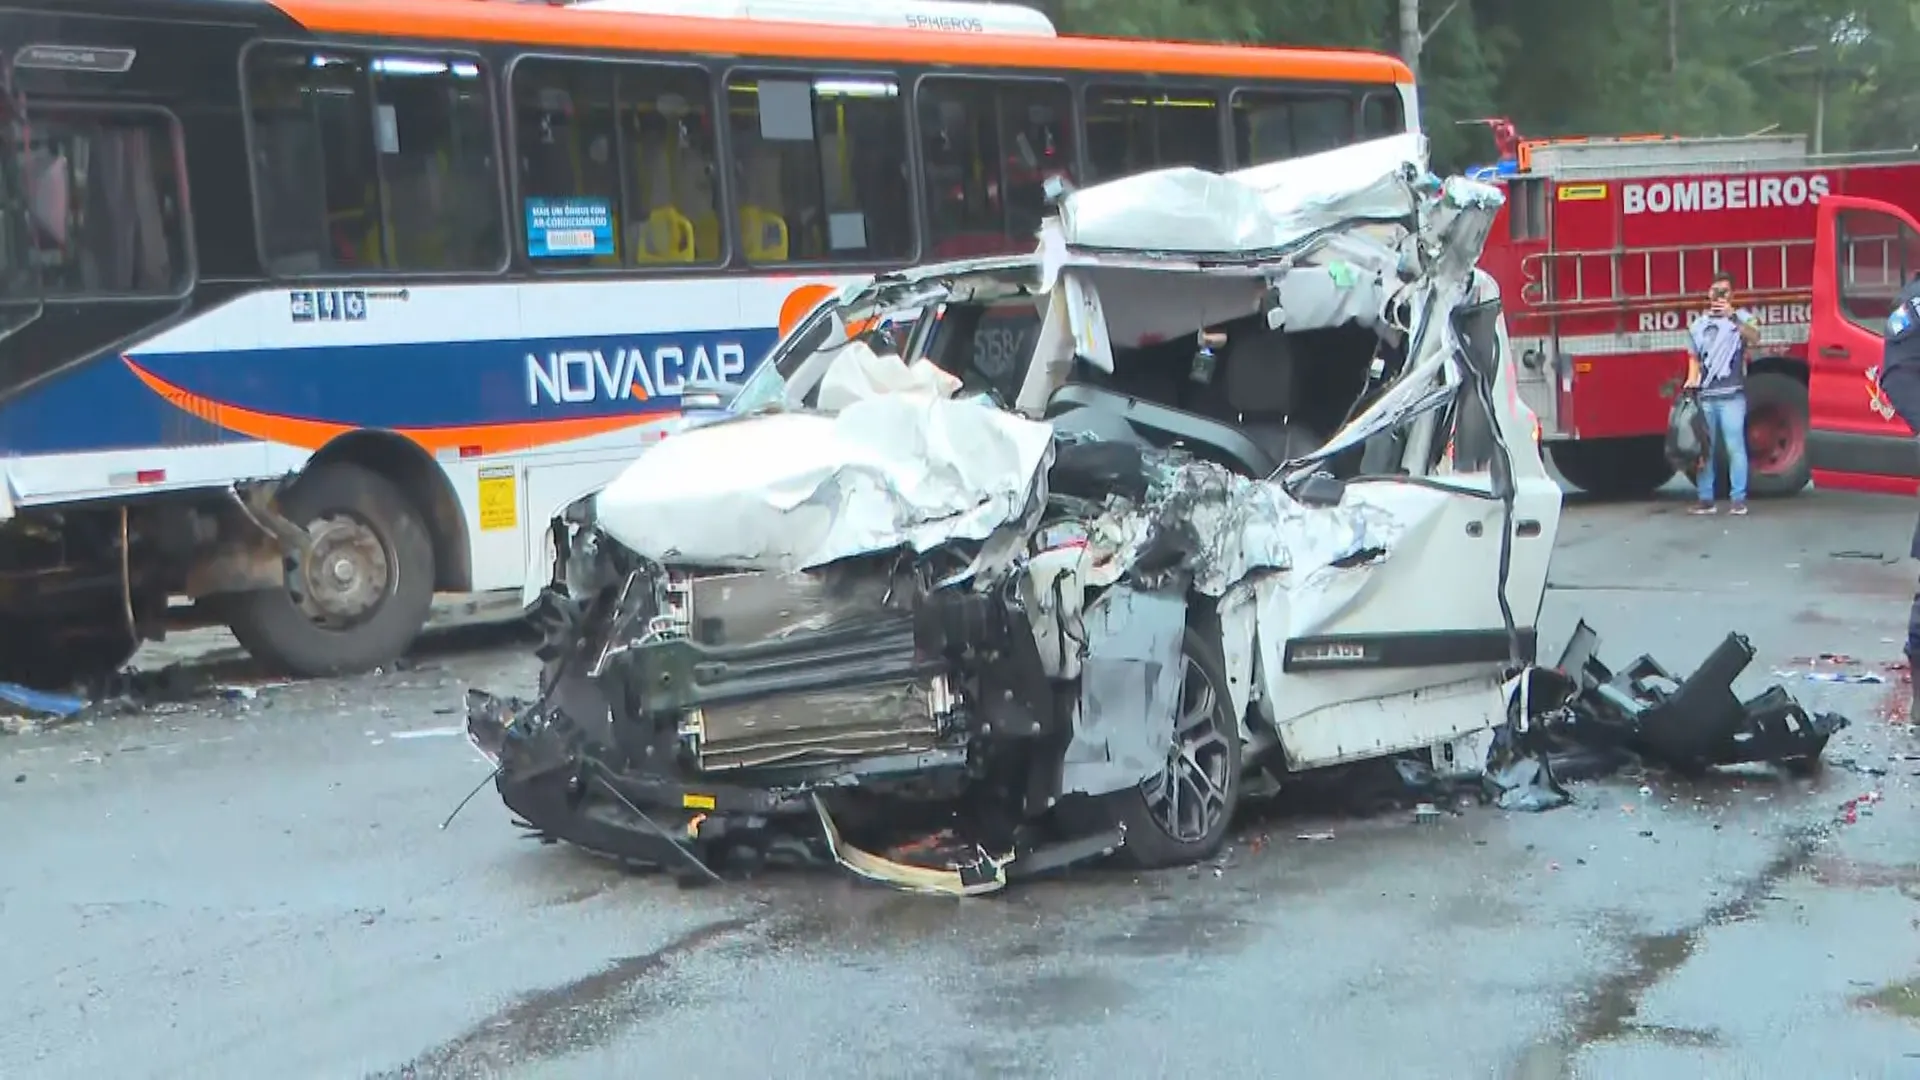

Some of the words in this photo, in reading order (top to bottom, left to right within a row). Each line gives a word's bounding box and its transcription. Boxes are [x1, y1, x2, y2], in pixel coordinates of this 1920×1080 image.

[905, 14, 983, 32] SPHEROS
[1623, 175, 1829, 215] BOMBEIROS
[1638, 311, 1680, 332] RIO
[526, 342, 746, 405] NOVACAP
